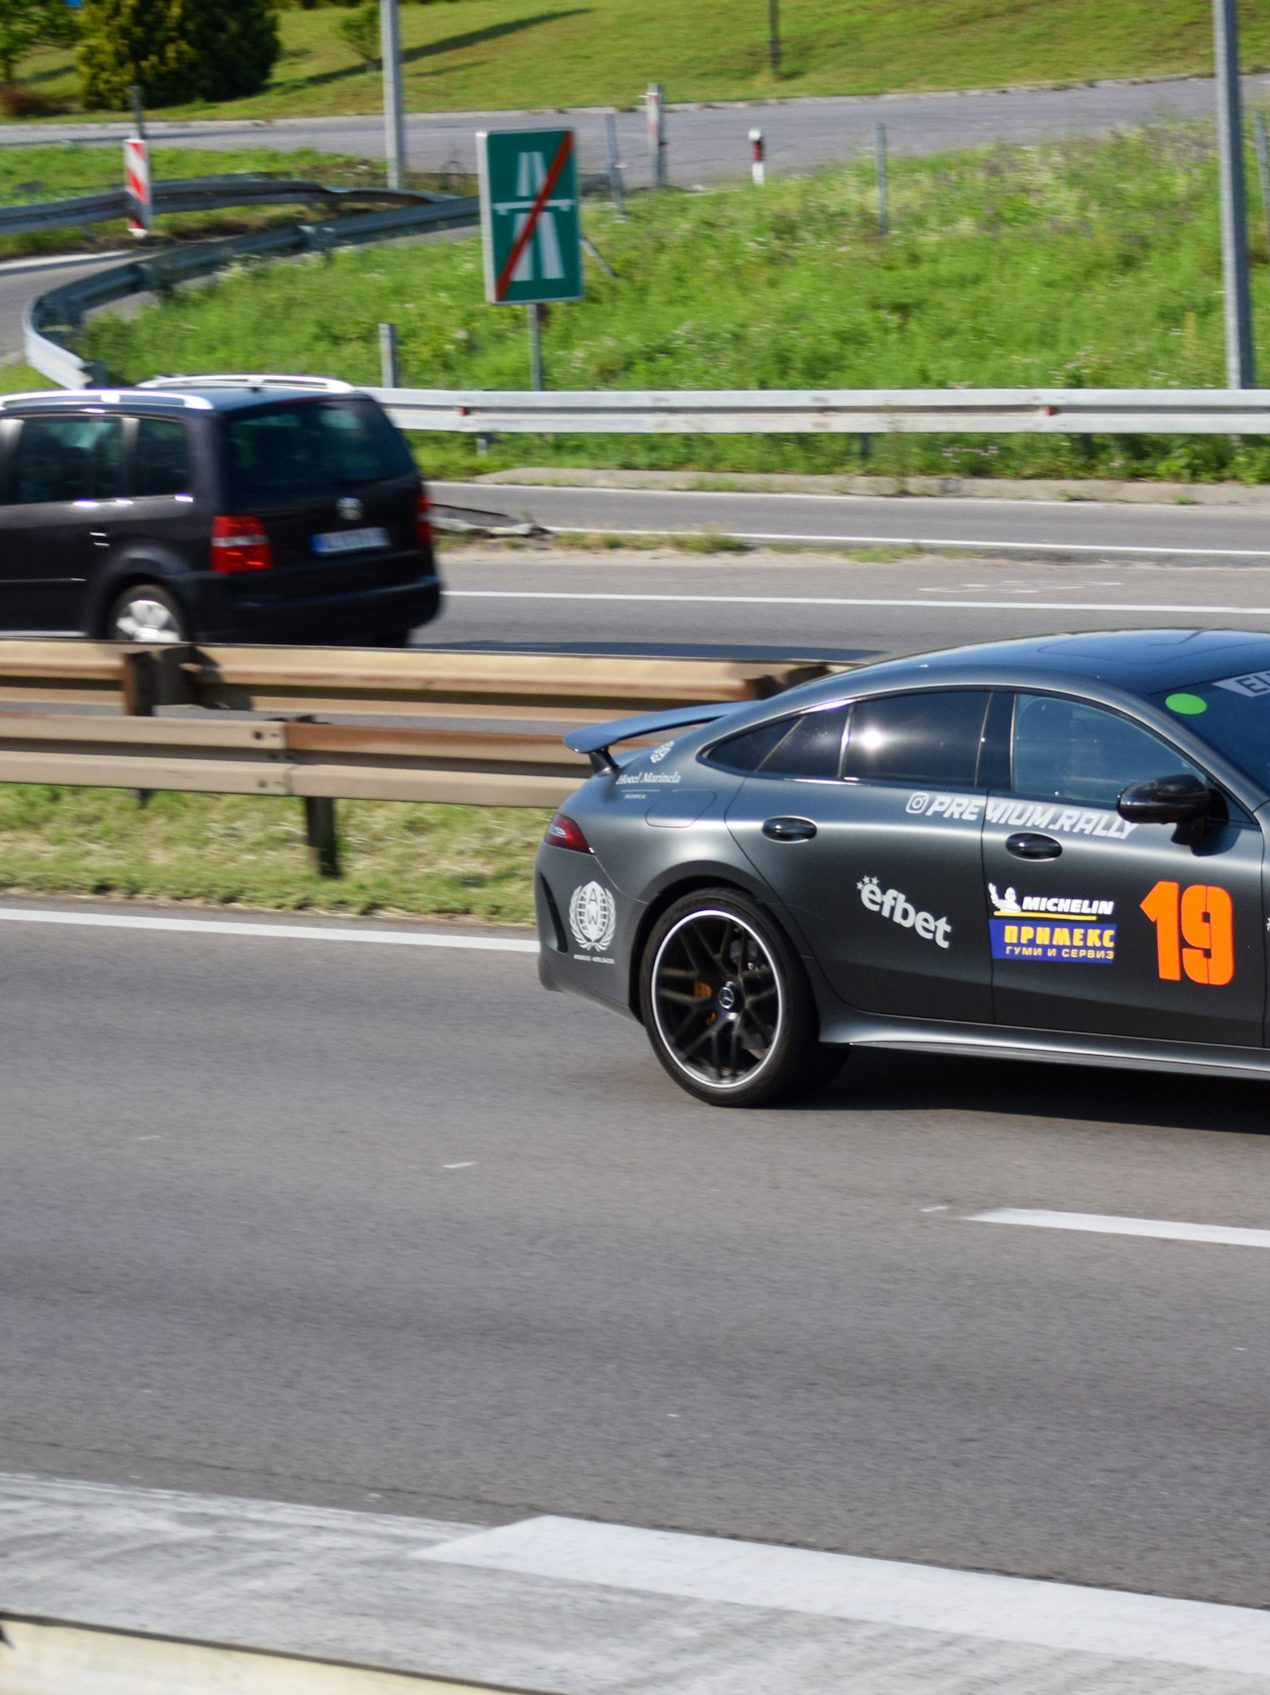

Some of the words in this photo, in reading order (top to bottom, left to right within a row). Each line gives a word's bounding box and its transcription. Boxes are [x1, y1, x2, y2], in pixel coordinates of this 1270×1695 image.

[616, 772, 642, 786] Hotel
[925, 795, 1139, 840] PREMIUM.RALLY
[859, 880, 952, 949] efbet
[1021, 896, 1115, 915] MICHELIN
[1003, 925, 1115, 948] ПРИМЕКС
[1139, 880, 1234, 986] 19
[1005, 946, 1043, 957] ГУМИ
[1047, 948, 1057, 957] И
[1061, 948, 1115, 960] СЕРВИЗ
